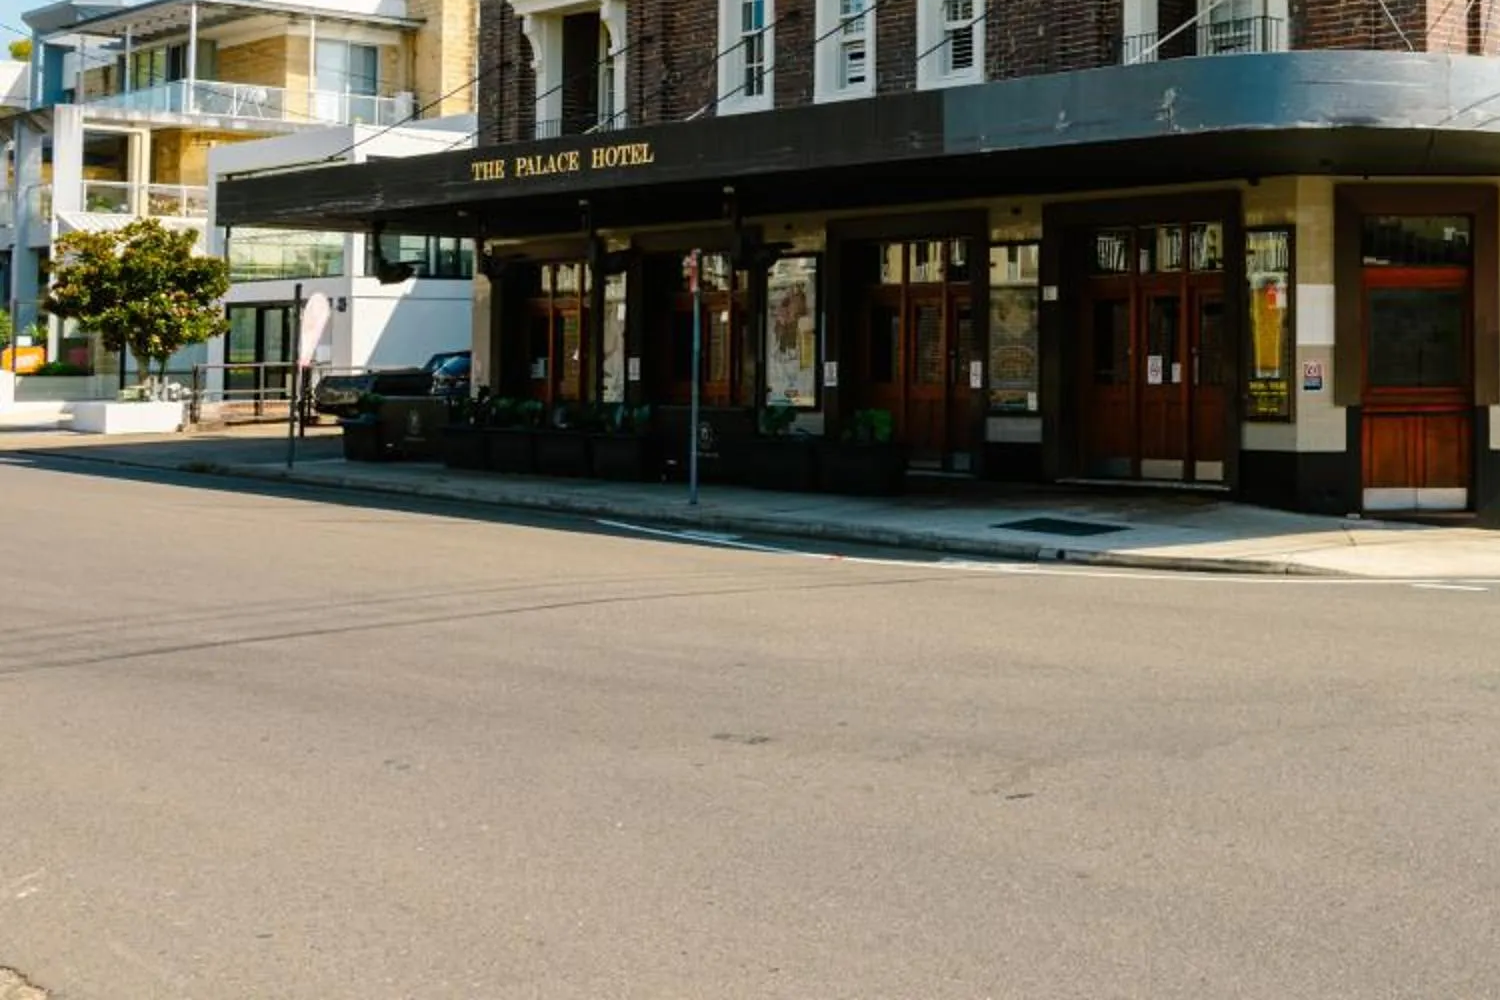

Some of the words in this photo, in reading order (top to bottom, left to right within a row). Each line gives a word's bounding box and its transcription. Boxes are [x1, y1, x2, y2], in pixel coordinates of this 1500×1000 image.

[471, 159, 505, 182] THE
[515, 150, 580, 178] PALACE
[592, 142, 655, 169] HOTEL
